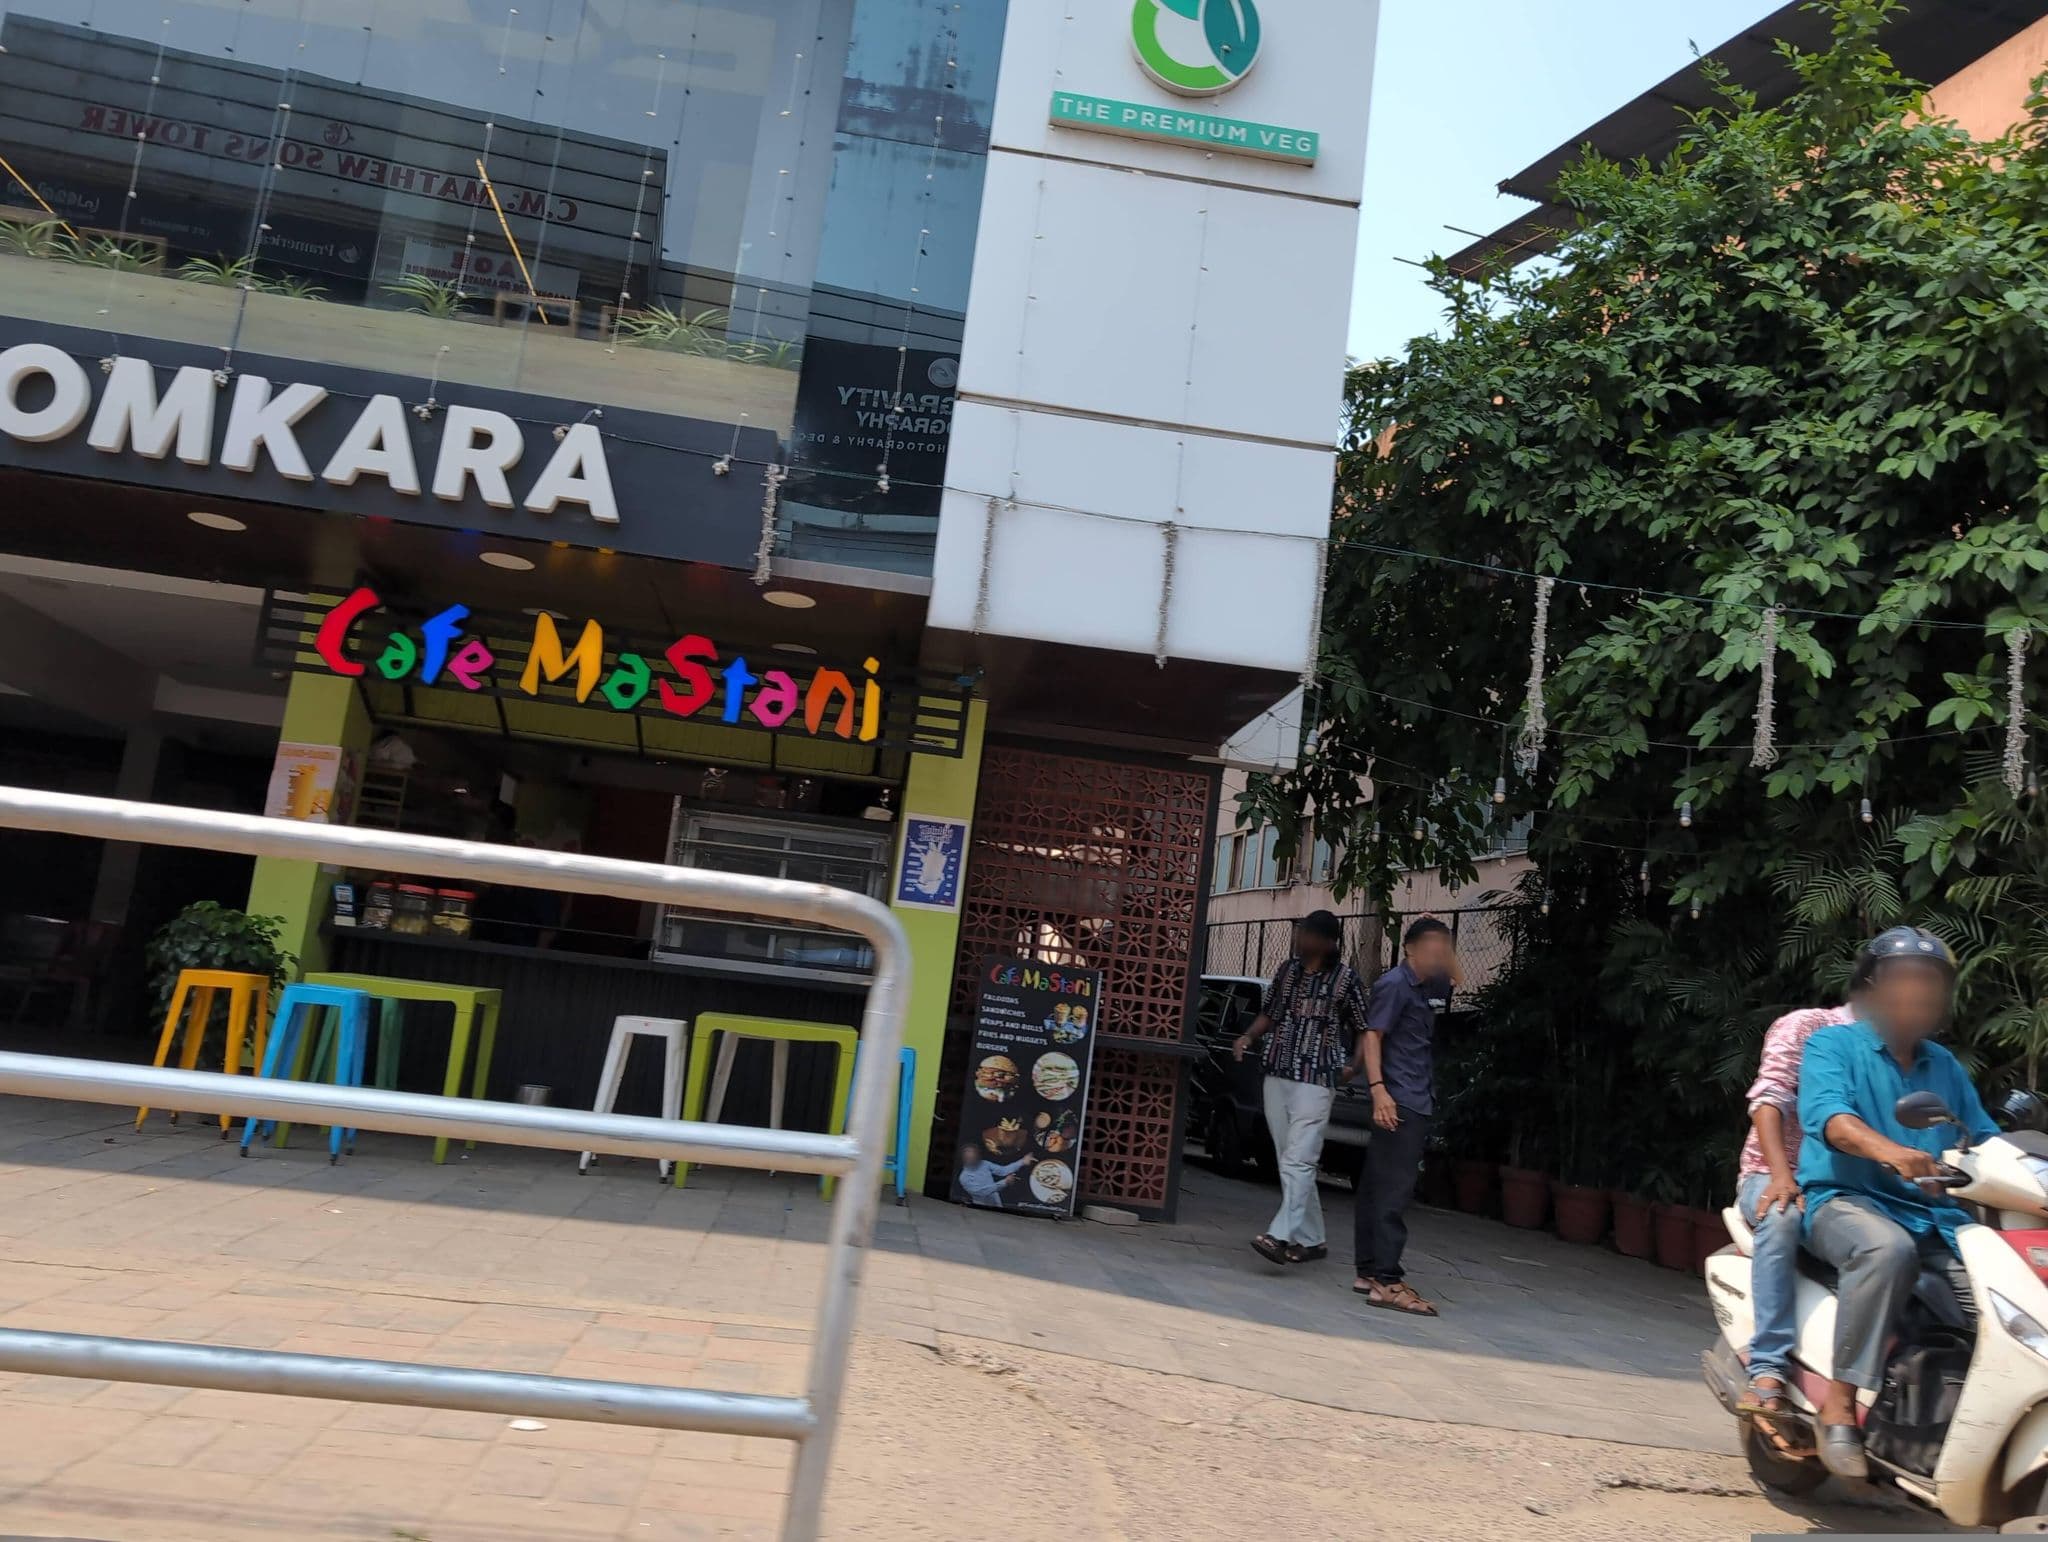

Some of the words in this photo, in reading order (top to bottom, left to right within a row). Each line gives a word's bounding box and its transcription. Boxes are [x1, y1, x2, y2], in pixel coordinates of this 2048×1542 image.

[1060, 97, 1111, 120] THE
[1123, 107, 1248, 142] PREMIUM
[1260, 130, 1312, 153] VEG
[0, 343, 620, 523] OMKARA
[313, 587, 495, 691] Cafe
[990, 963, 1021, 987] Cafe
